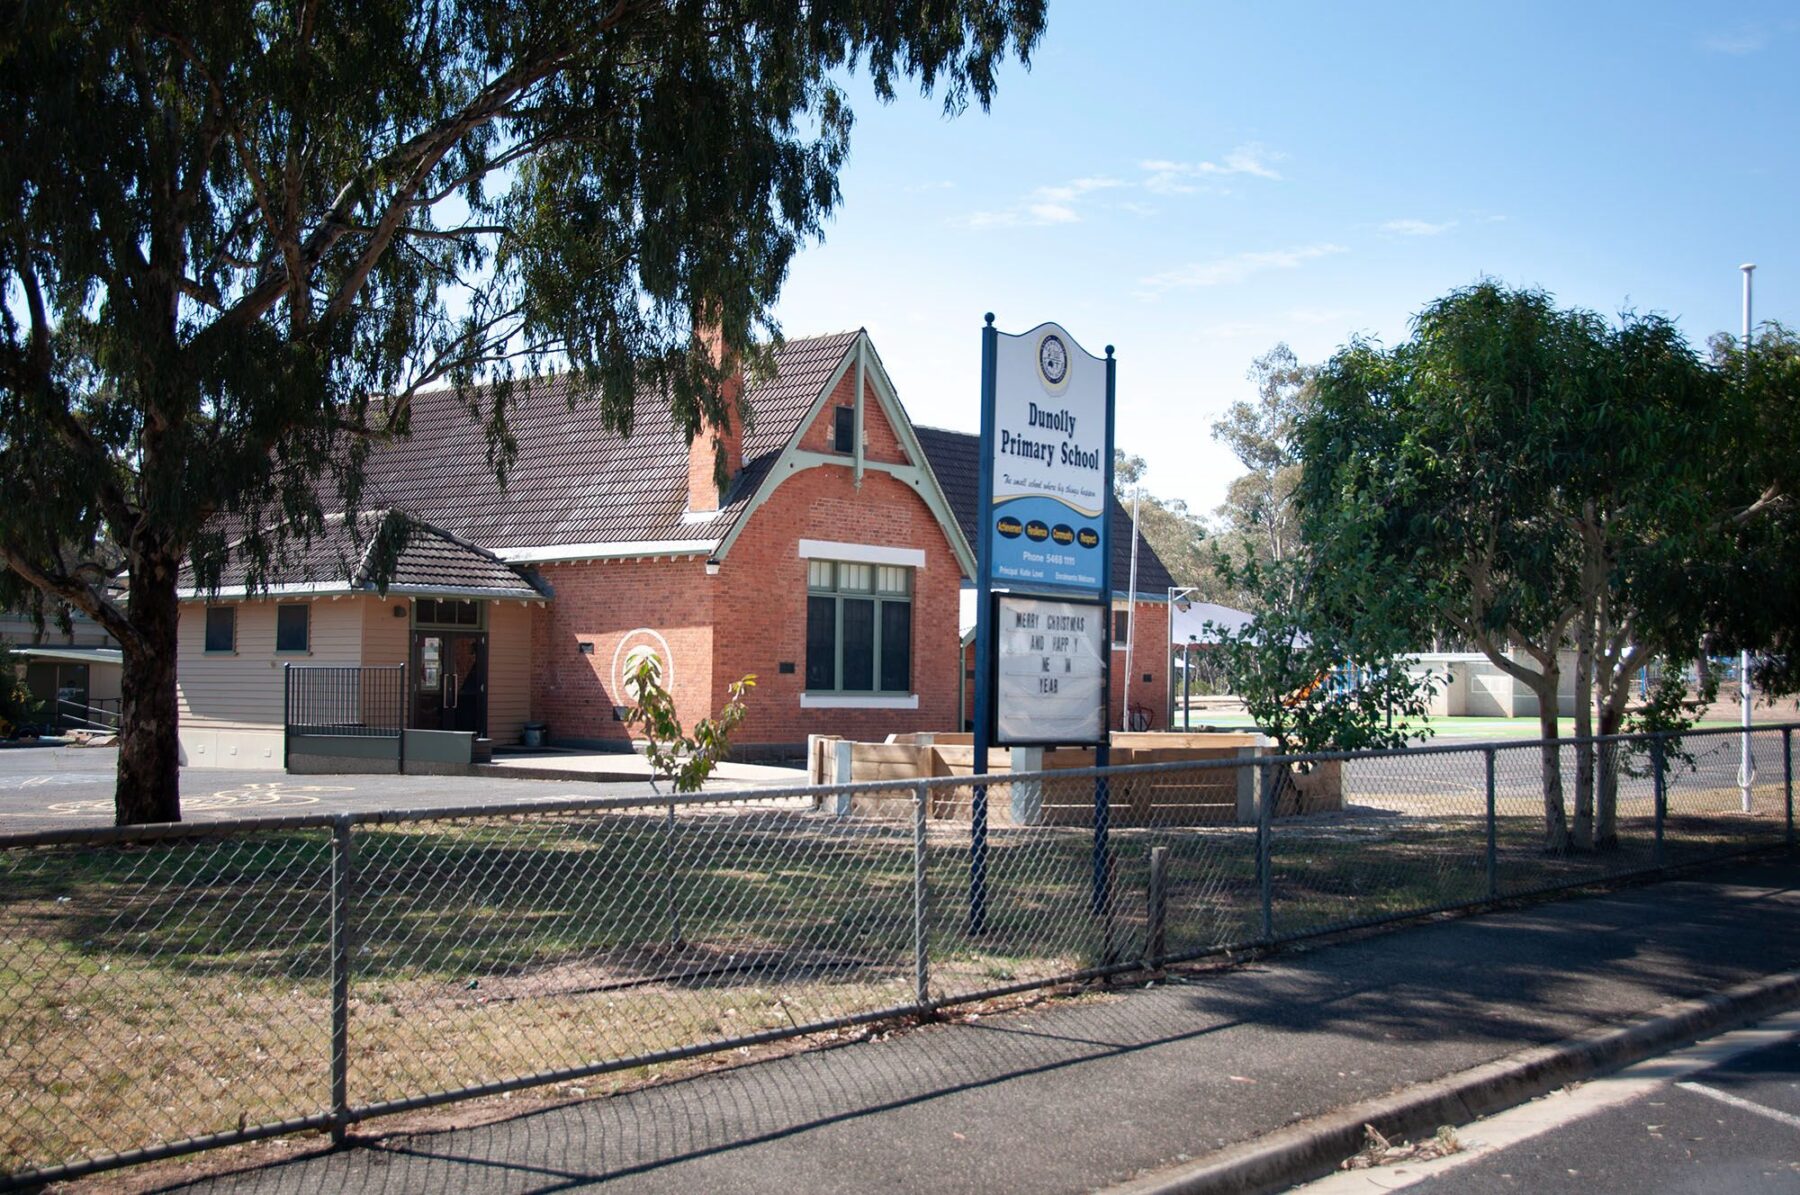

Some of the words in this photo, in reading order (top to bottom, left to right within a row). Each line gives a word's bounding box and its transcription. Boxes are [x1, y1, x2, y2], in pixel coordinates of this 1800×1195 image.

[1028, 402, 1076, 439] Dunolly
[1001, 429, 1055, 467] Primary
[1061, 441, 1099, 470] School
[1003, 474, 1013, 484] The
[1013, 478, 1026, 487] small
[1028, 479, 1042, 489] school
[1043, 480, 1056, 491] where
[1023, 550, 1044, 562] Phone
[999, 566, 1018, 577] Principal
[1016, 612, 1039, 628] MERRY
[1047, 615, 1085, 632] CHRISTMAS
[1031, 635, 1044, 651] AND
[1039, 678, 1058, 694] YEAR
